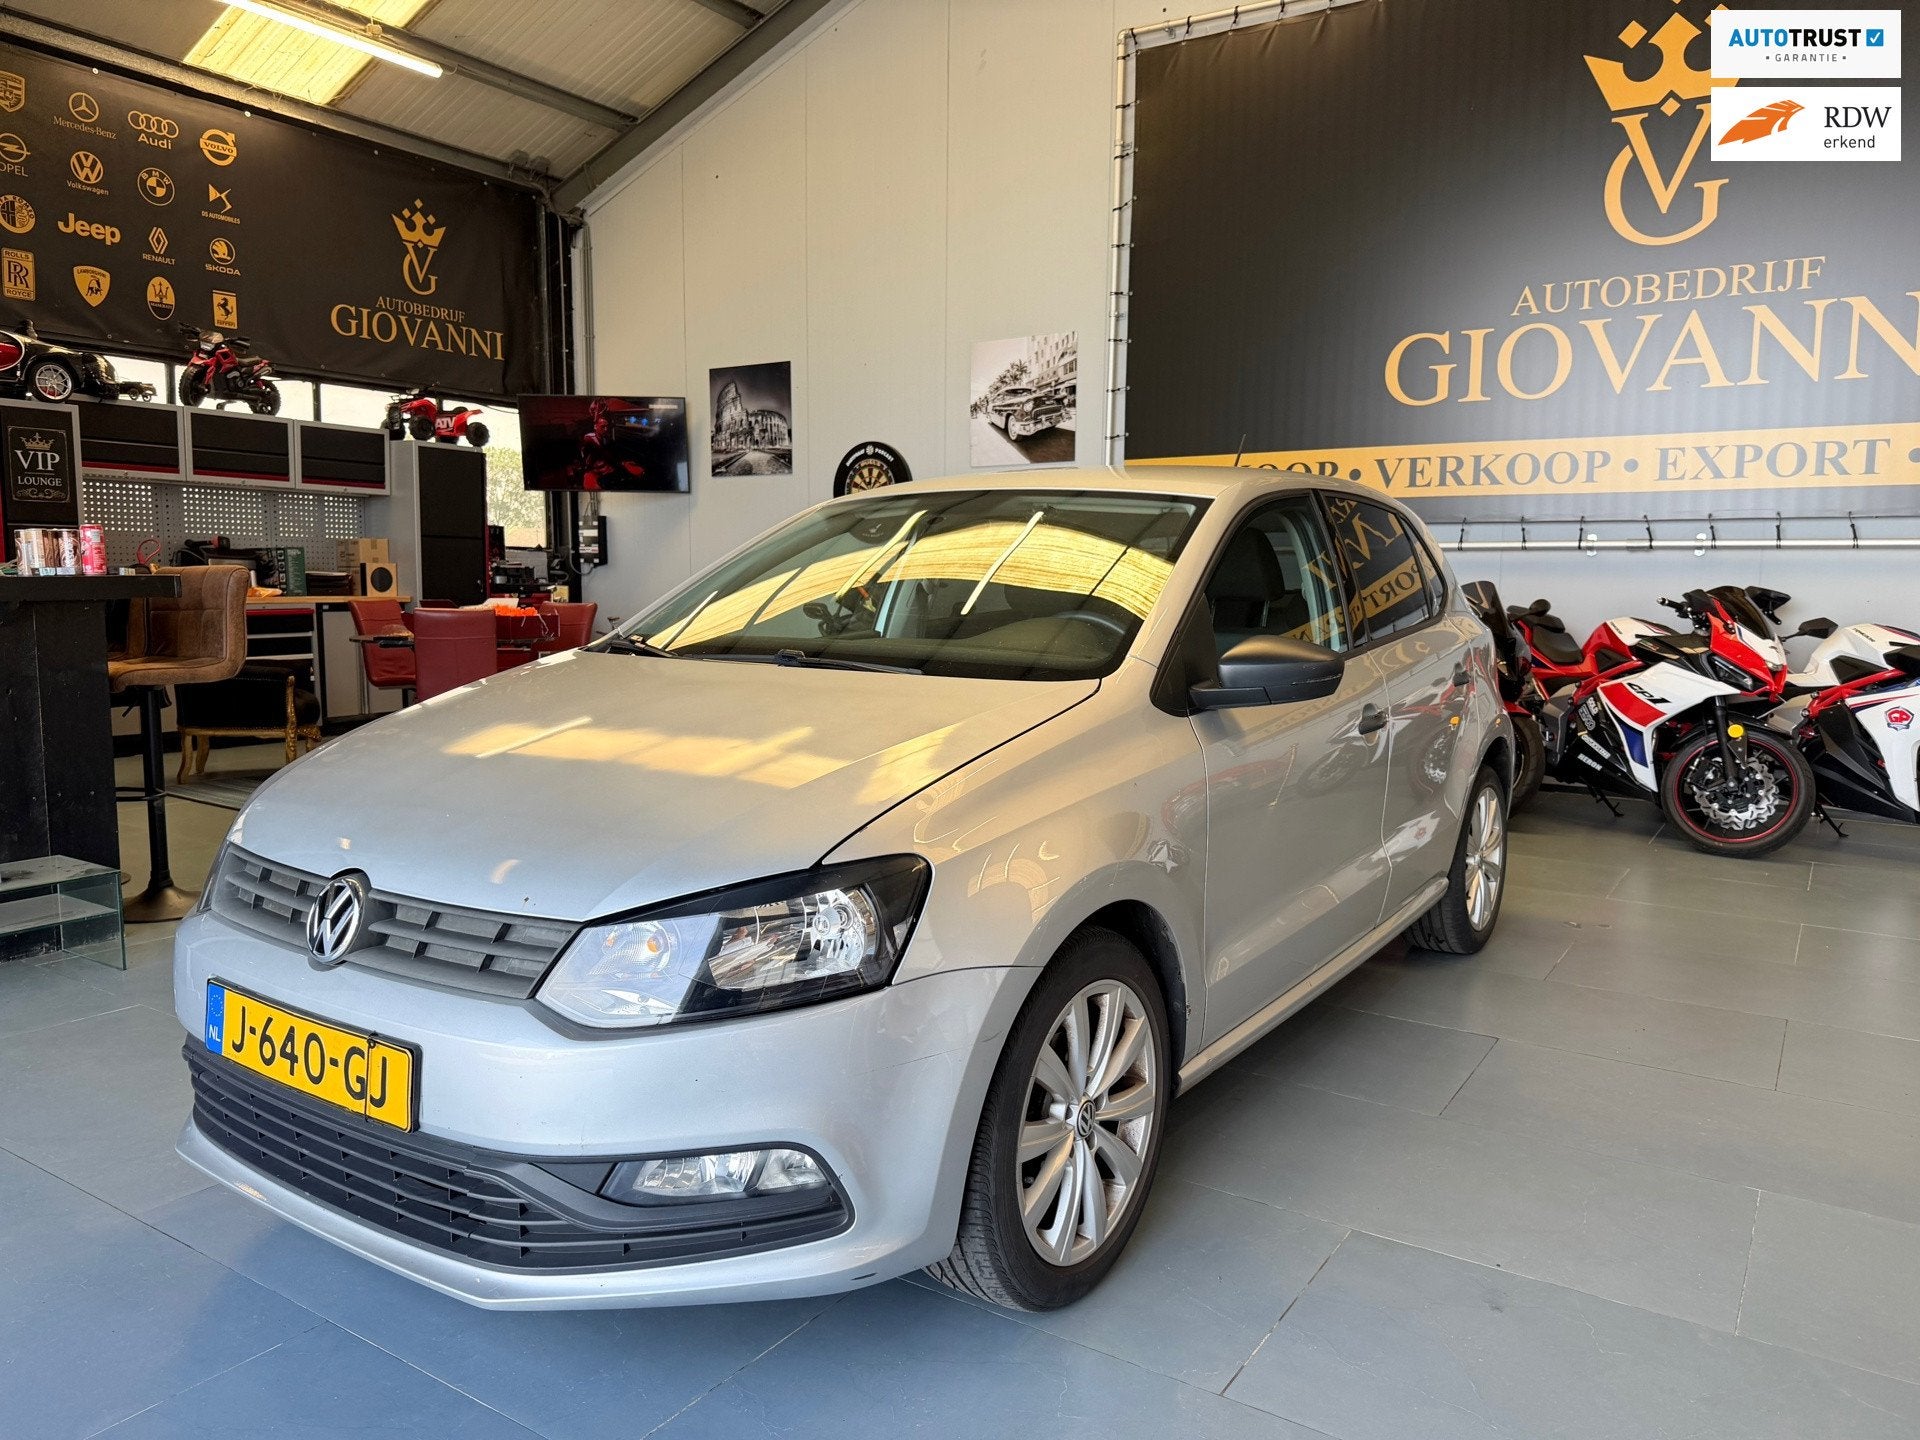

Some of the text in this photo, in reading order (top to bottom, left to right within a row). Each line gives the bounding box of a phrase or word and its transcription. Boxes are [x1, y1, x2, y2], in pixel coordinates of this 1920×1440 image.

[53, 115, 117, 140] Mercedes-Benz
[138, 133, 172, 150] Audi
[203, 142, 234, 154] VOLVO
[141, 171, 171, 185] BMW
[67, 180, 109, 196] Volkswagen
[58, 213, 121, 245] Jeep
[5, 250, 30, 260] ROLLS
[142, 253, 176, 265] RENAULT
[6, 287, 32, 299] ROYCE
[1511, 255, 1826, 317] AUTOBEDRIJF
[376, 296, 466, 323] AUTOBEDRIJF
[330, 303, 505, 361] GIOVANNI
[435, 416, 456, 429] ATV
[14, 450, 60, 471] VIP
[1374, 451, 1611, 488] VERKOOP
[1654, 438, 1892, 482] EXPORT
[17, 475, 62, 487] LOUNGE
[209, 1024, 221, 1042] NL
[231, 1005, 388, 1109] J-640-GJ
